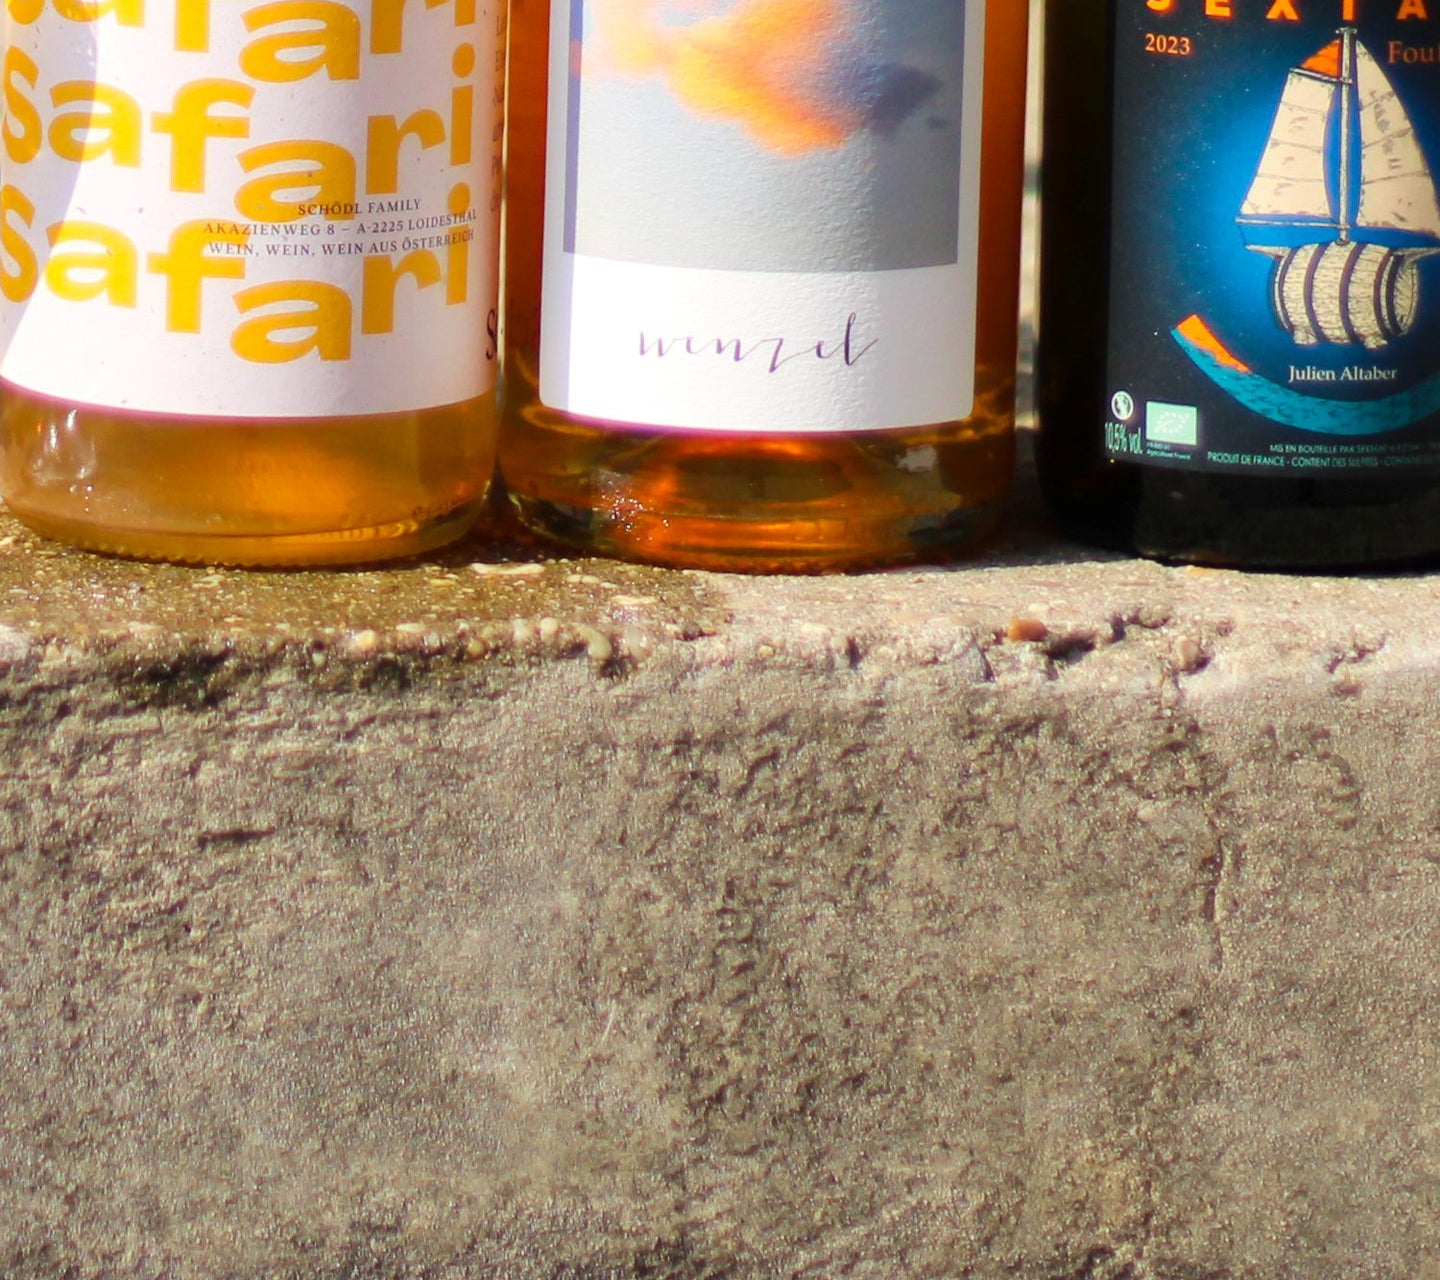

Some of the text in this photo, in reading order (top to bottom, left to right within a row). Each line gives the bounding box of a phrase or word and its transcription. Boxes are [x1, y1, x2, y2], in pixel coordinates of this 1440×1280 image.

[1145, 33, 1191, 56] 2023
[297, 198, 422, 216] SCHÖDL FAMILY
[203, 223, 321, 236] AKAZIENWEG
[326, 224, 335, 236] 8
[356, 220, 404, 235] A-2225
[209, 242, 260, 257] WEIN,
[322, 242, 364, 256] WEIN
[369, 241, 397, 254] AUS
[402, 229, 475, 251] ÖSTERREICH
[1288, 365, 1398, 383] Julien Altaber
[1253, 454, 1285, 466] FRANCE
